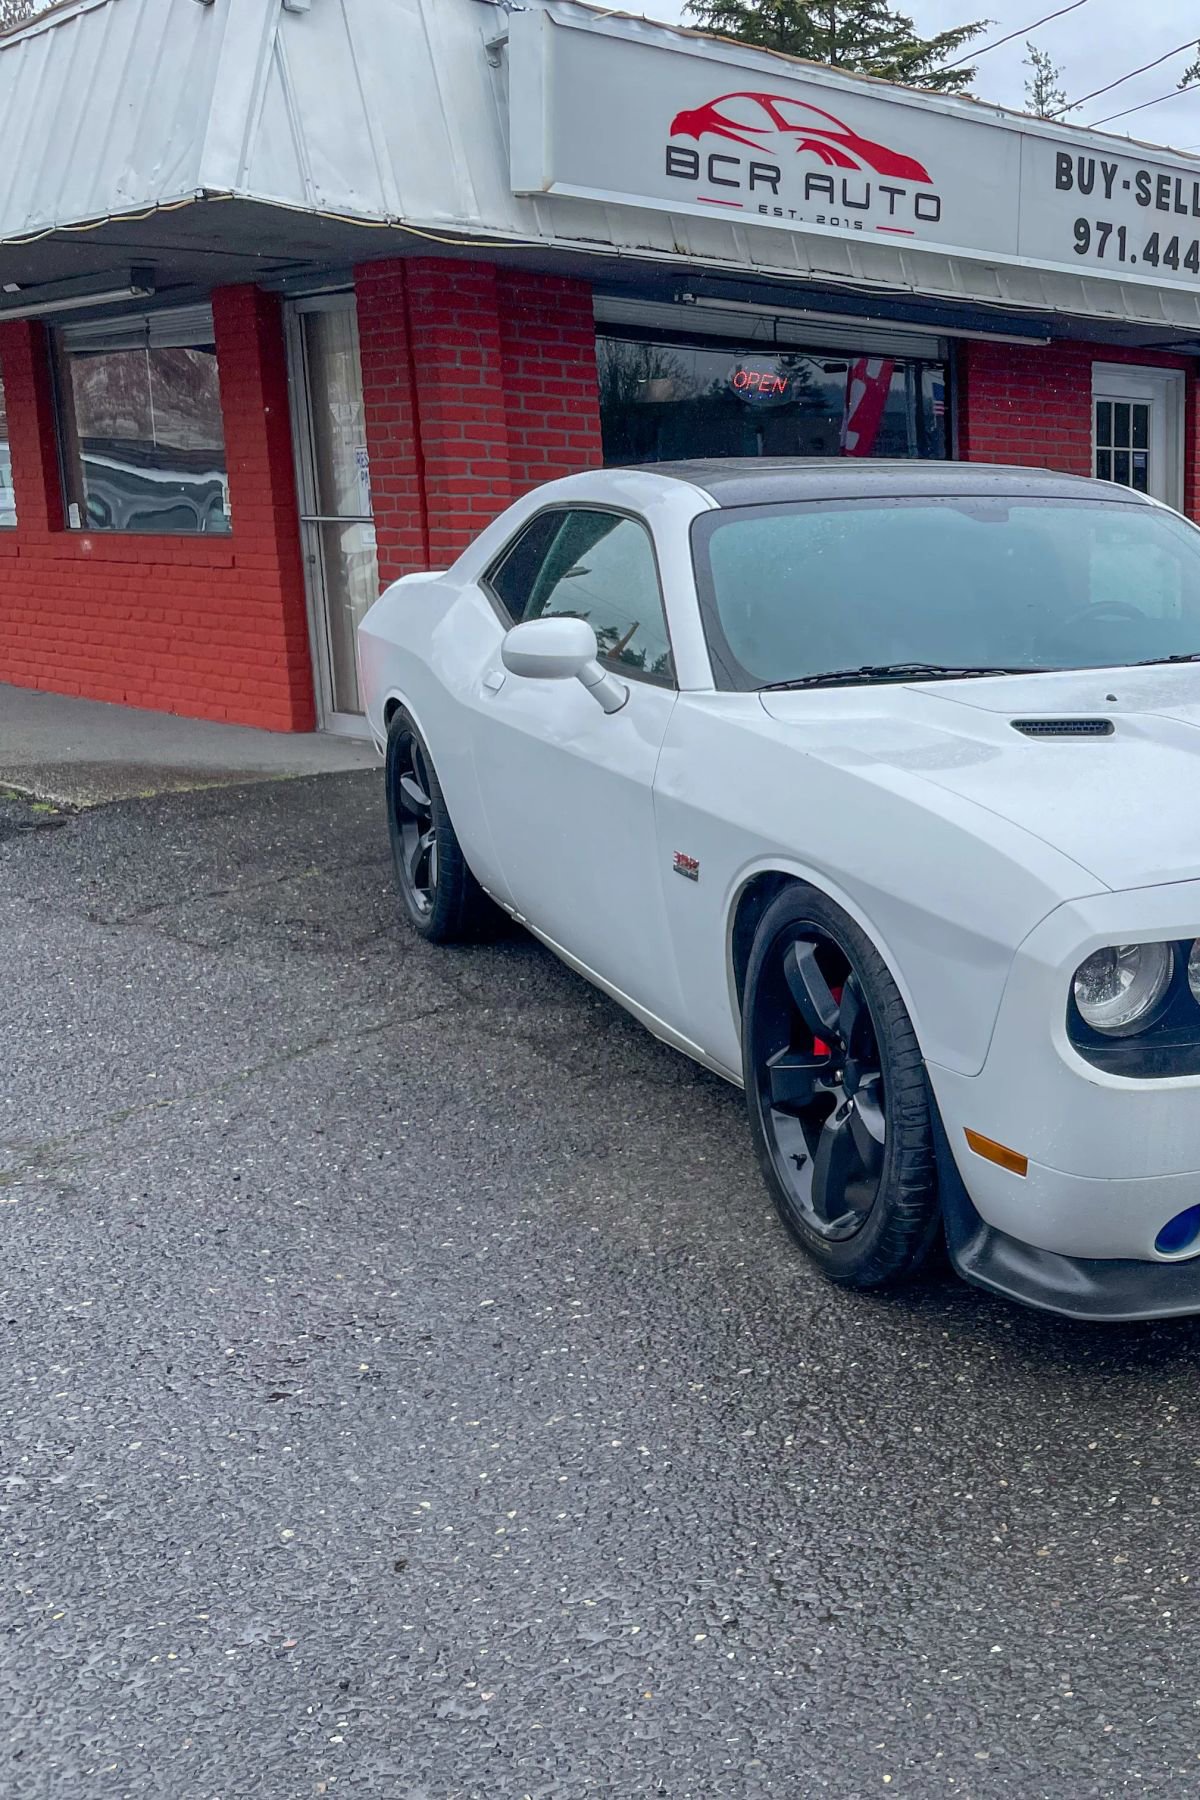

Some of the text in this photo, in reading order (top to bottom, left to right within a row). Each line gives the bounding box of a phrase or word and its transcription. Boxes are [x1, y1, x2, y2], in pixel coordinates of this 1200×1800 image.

[665, 145, 941, 222] BCR AUTO
[758, 204, 863, 230] EST. 2015
[733, 370, 788, 393] OPEN
